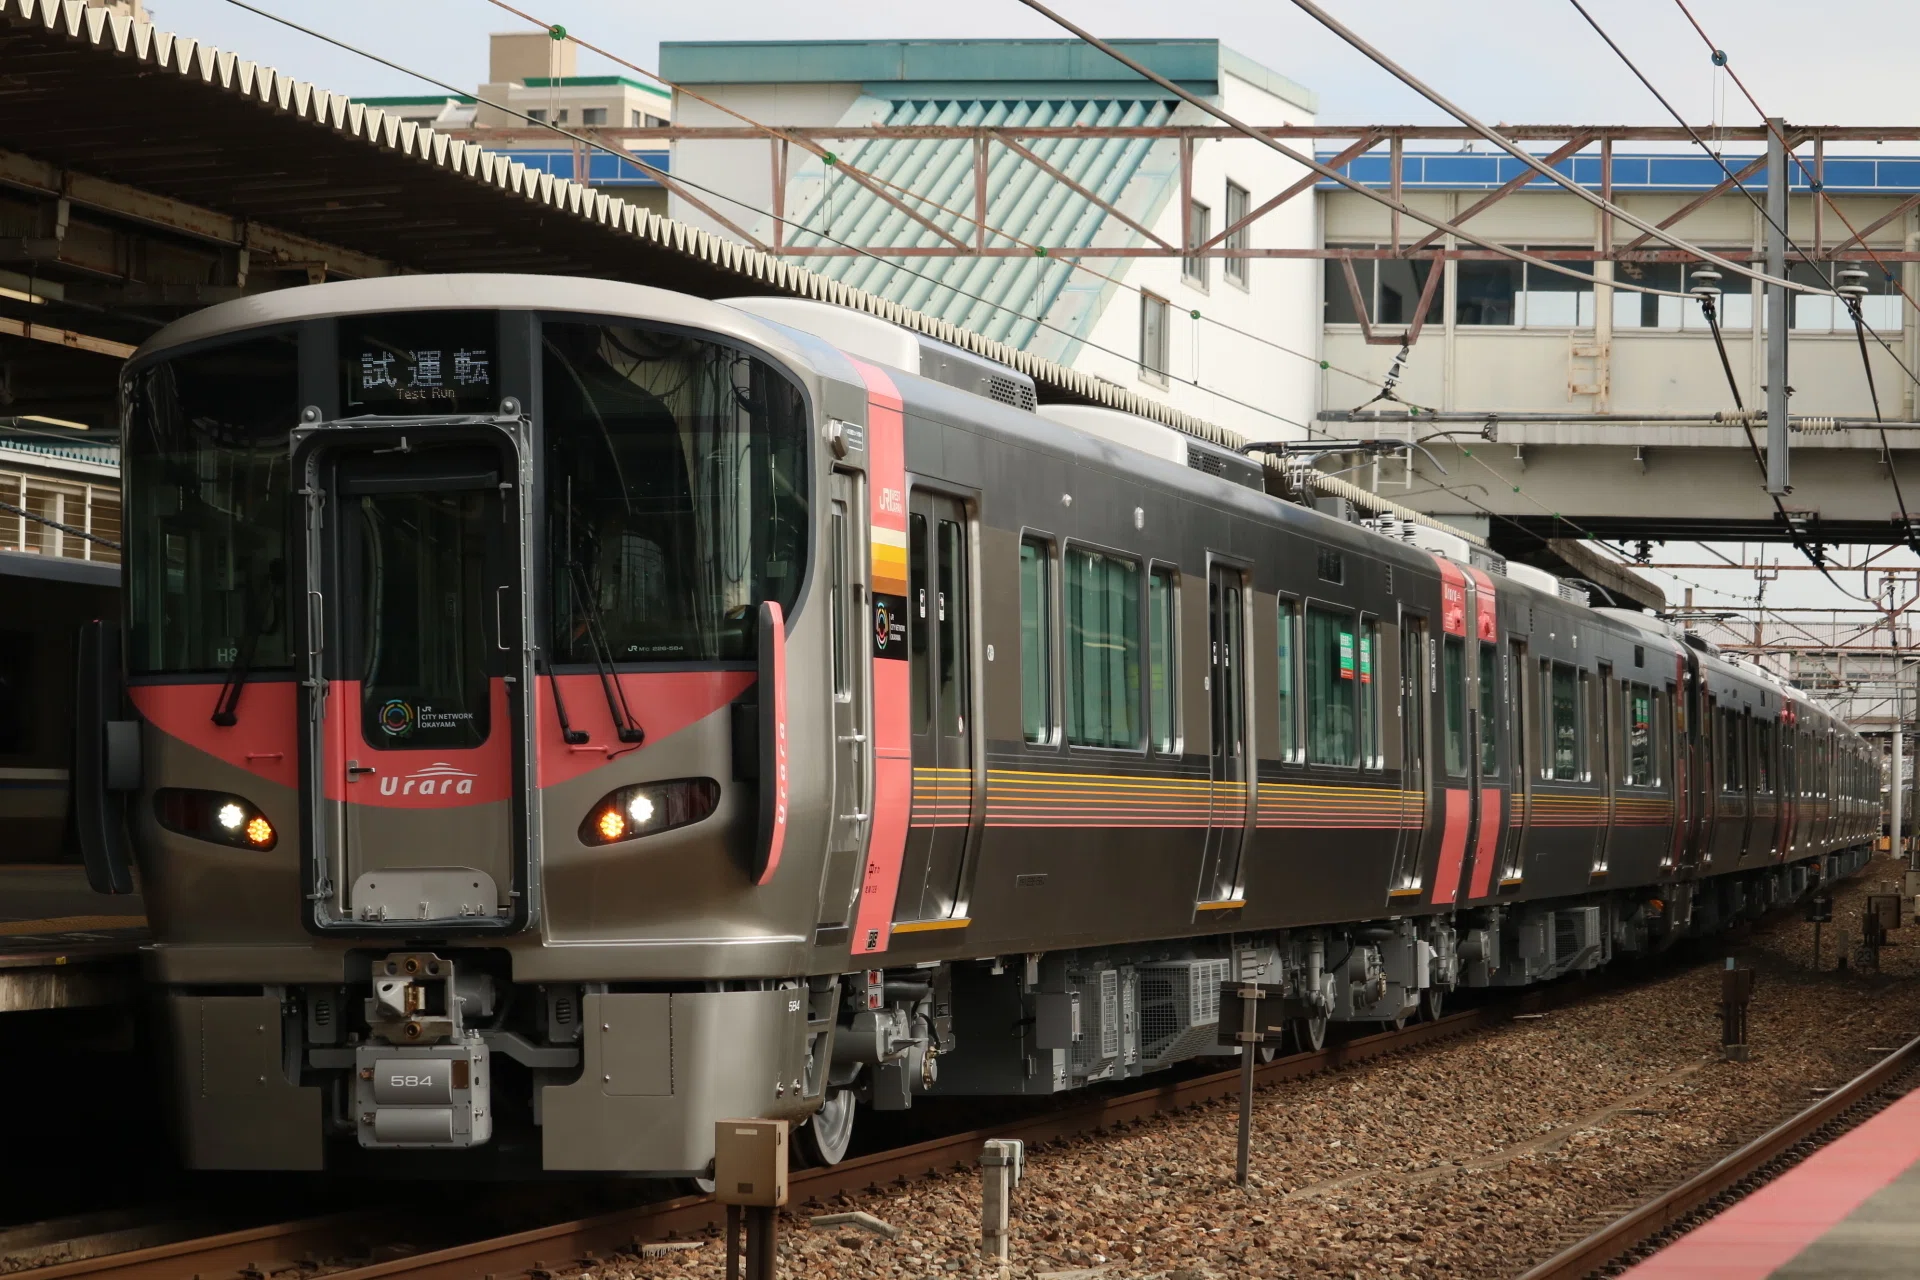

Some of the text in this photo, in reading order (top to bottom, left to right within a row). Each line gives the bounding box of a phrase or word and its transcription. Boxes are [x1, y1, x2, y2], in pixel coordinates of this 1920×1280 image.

[361, 348, 489, 388] 試運転
[397, 387, 455, 400] Test Run
[380, 776, 472, 796] Urara
[788, 1000, 800, 1012] 584
[391, 1076, 432, 1086] 584
